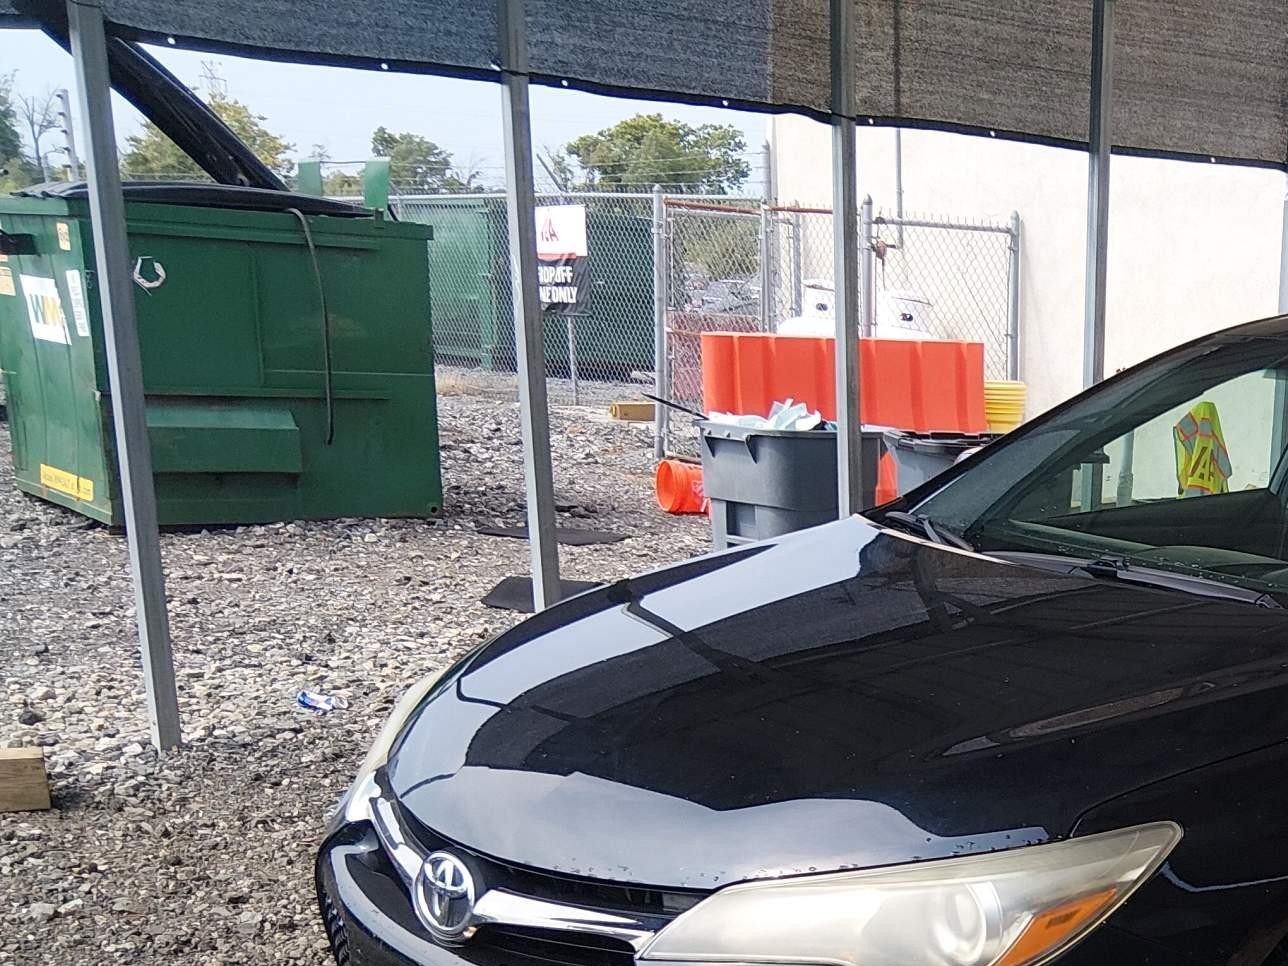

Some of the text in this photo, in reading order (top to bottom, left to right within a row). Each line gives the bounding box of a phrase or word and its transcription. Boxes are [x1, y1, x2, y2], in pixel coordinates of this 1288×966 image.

[538, 266, 573, 283] ROP OFF
[552, 286, 577, 303] ONLY
